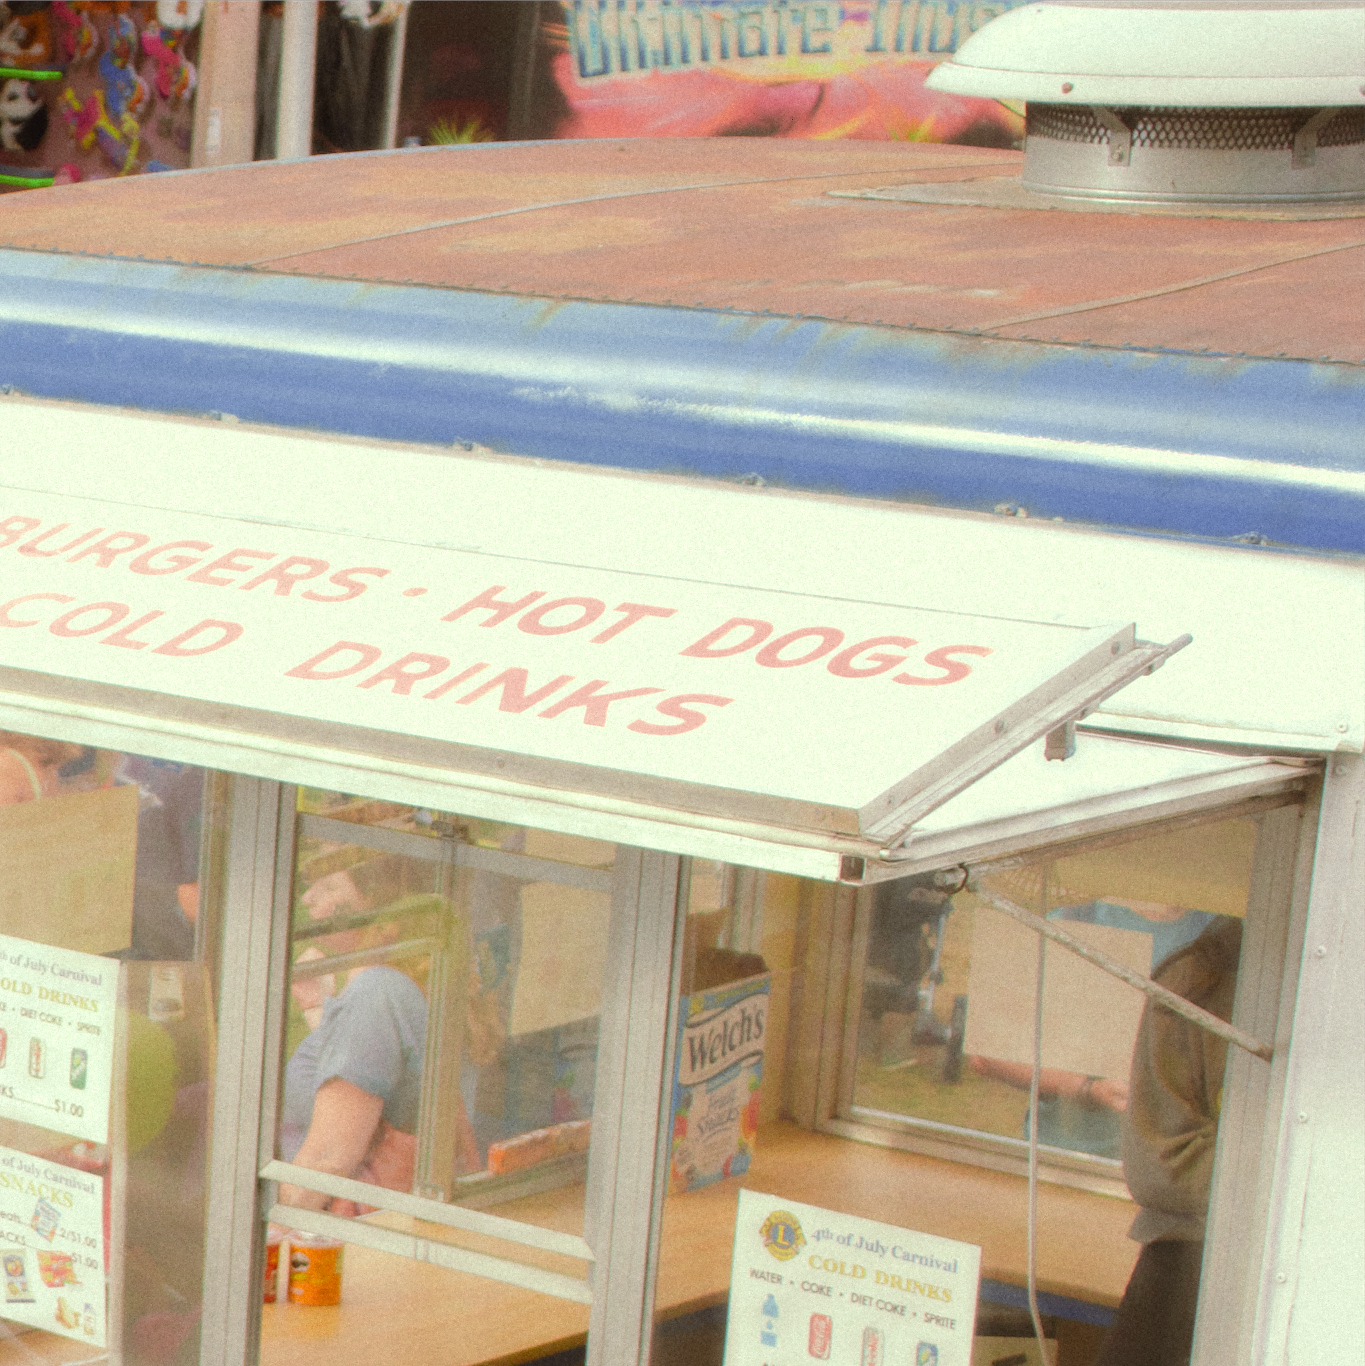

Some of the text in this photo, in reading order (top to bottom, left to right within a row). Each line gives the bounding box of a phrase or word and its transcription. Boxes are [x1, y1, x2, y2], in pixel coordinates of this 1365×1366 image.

[440, 584, 676, 643] HOT
[678, 616, 995, 686] DOGS
[285, 640, 734, 736] DRINKS
[10, 953, 23, 966] of
[22, 957, 49, 976] July
[50, 963, 104, 986] Carnival
[37, 985, 99, 1013] DRINKS
[39, 1011, 63, 1026] COKE
[688, 1003, 765, 1073] Welch's
[53, 1098, 85, 1118] $1.00
[2, 1153, 16, 1168] of
[17, 1158, 41, 1178] July
[43, 1167, 96, 1195] Carnival
[71, 1251, 99, 1270] $1.00
[810, 1227, 959, 1274] 4th of July Carnival
[750, 1267, 957, 1331] WATER COKE DIET COKE SPRITE
[808, 1254, 953, 1304] COLD DRINKS
